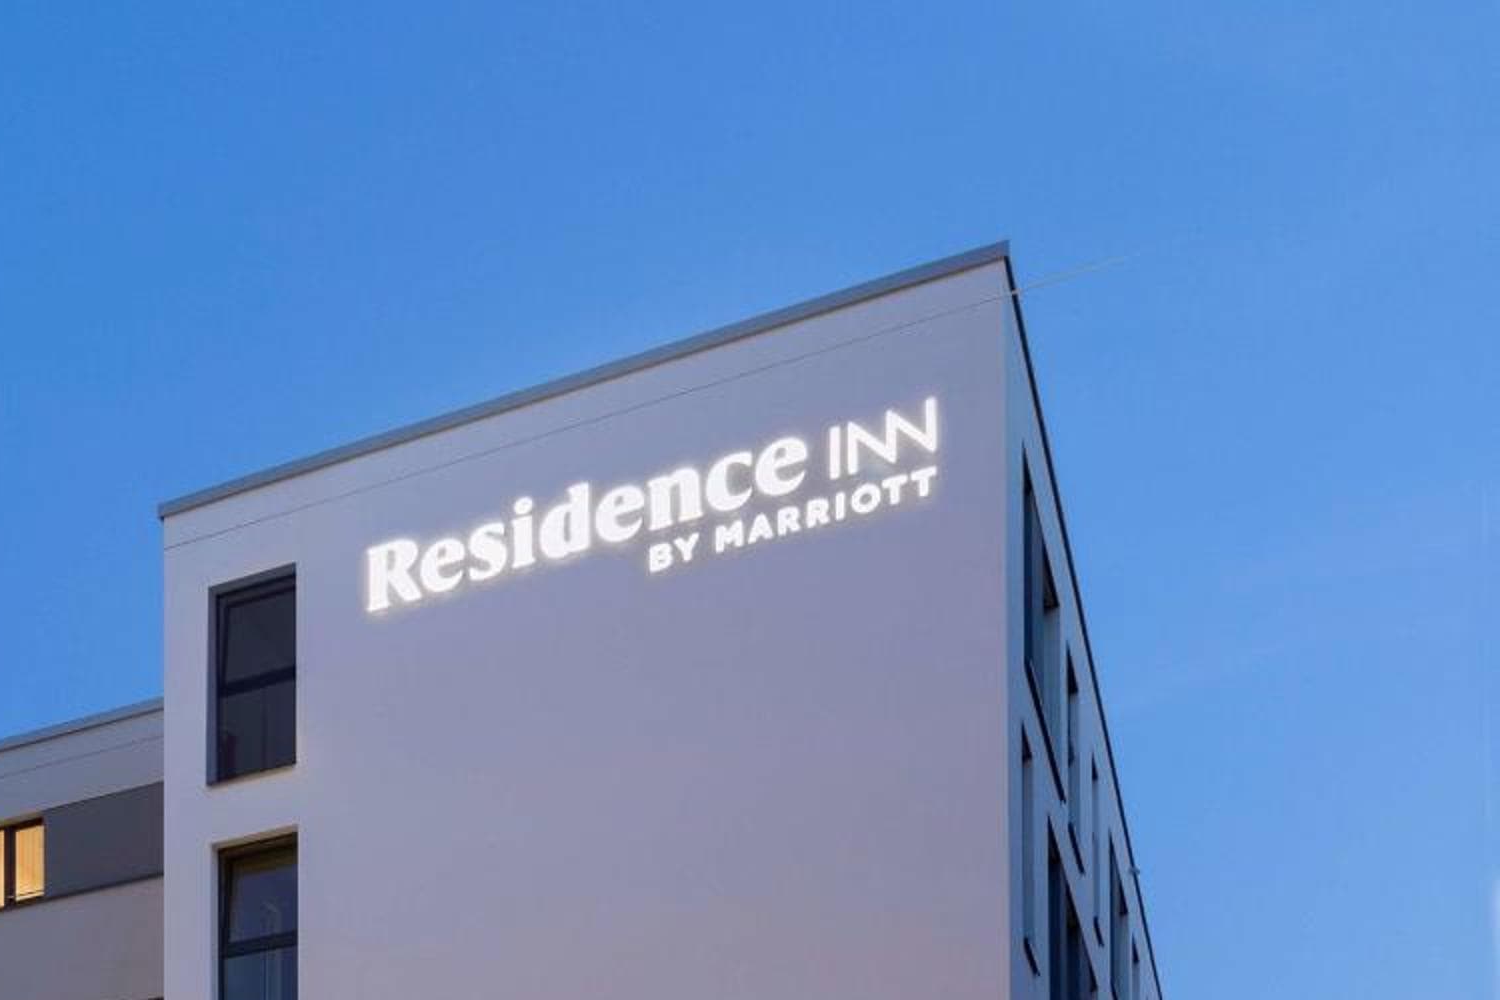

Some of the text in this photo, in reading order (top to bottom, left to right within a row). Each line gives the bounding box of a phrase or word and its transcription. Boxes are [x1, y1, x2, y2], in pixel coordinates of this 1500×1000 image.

[366, 397, 938, 614] Residence INN
[648, 466, 938, 574] BY MARRIOTT
